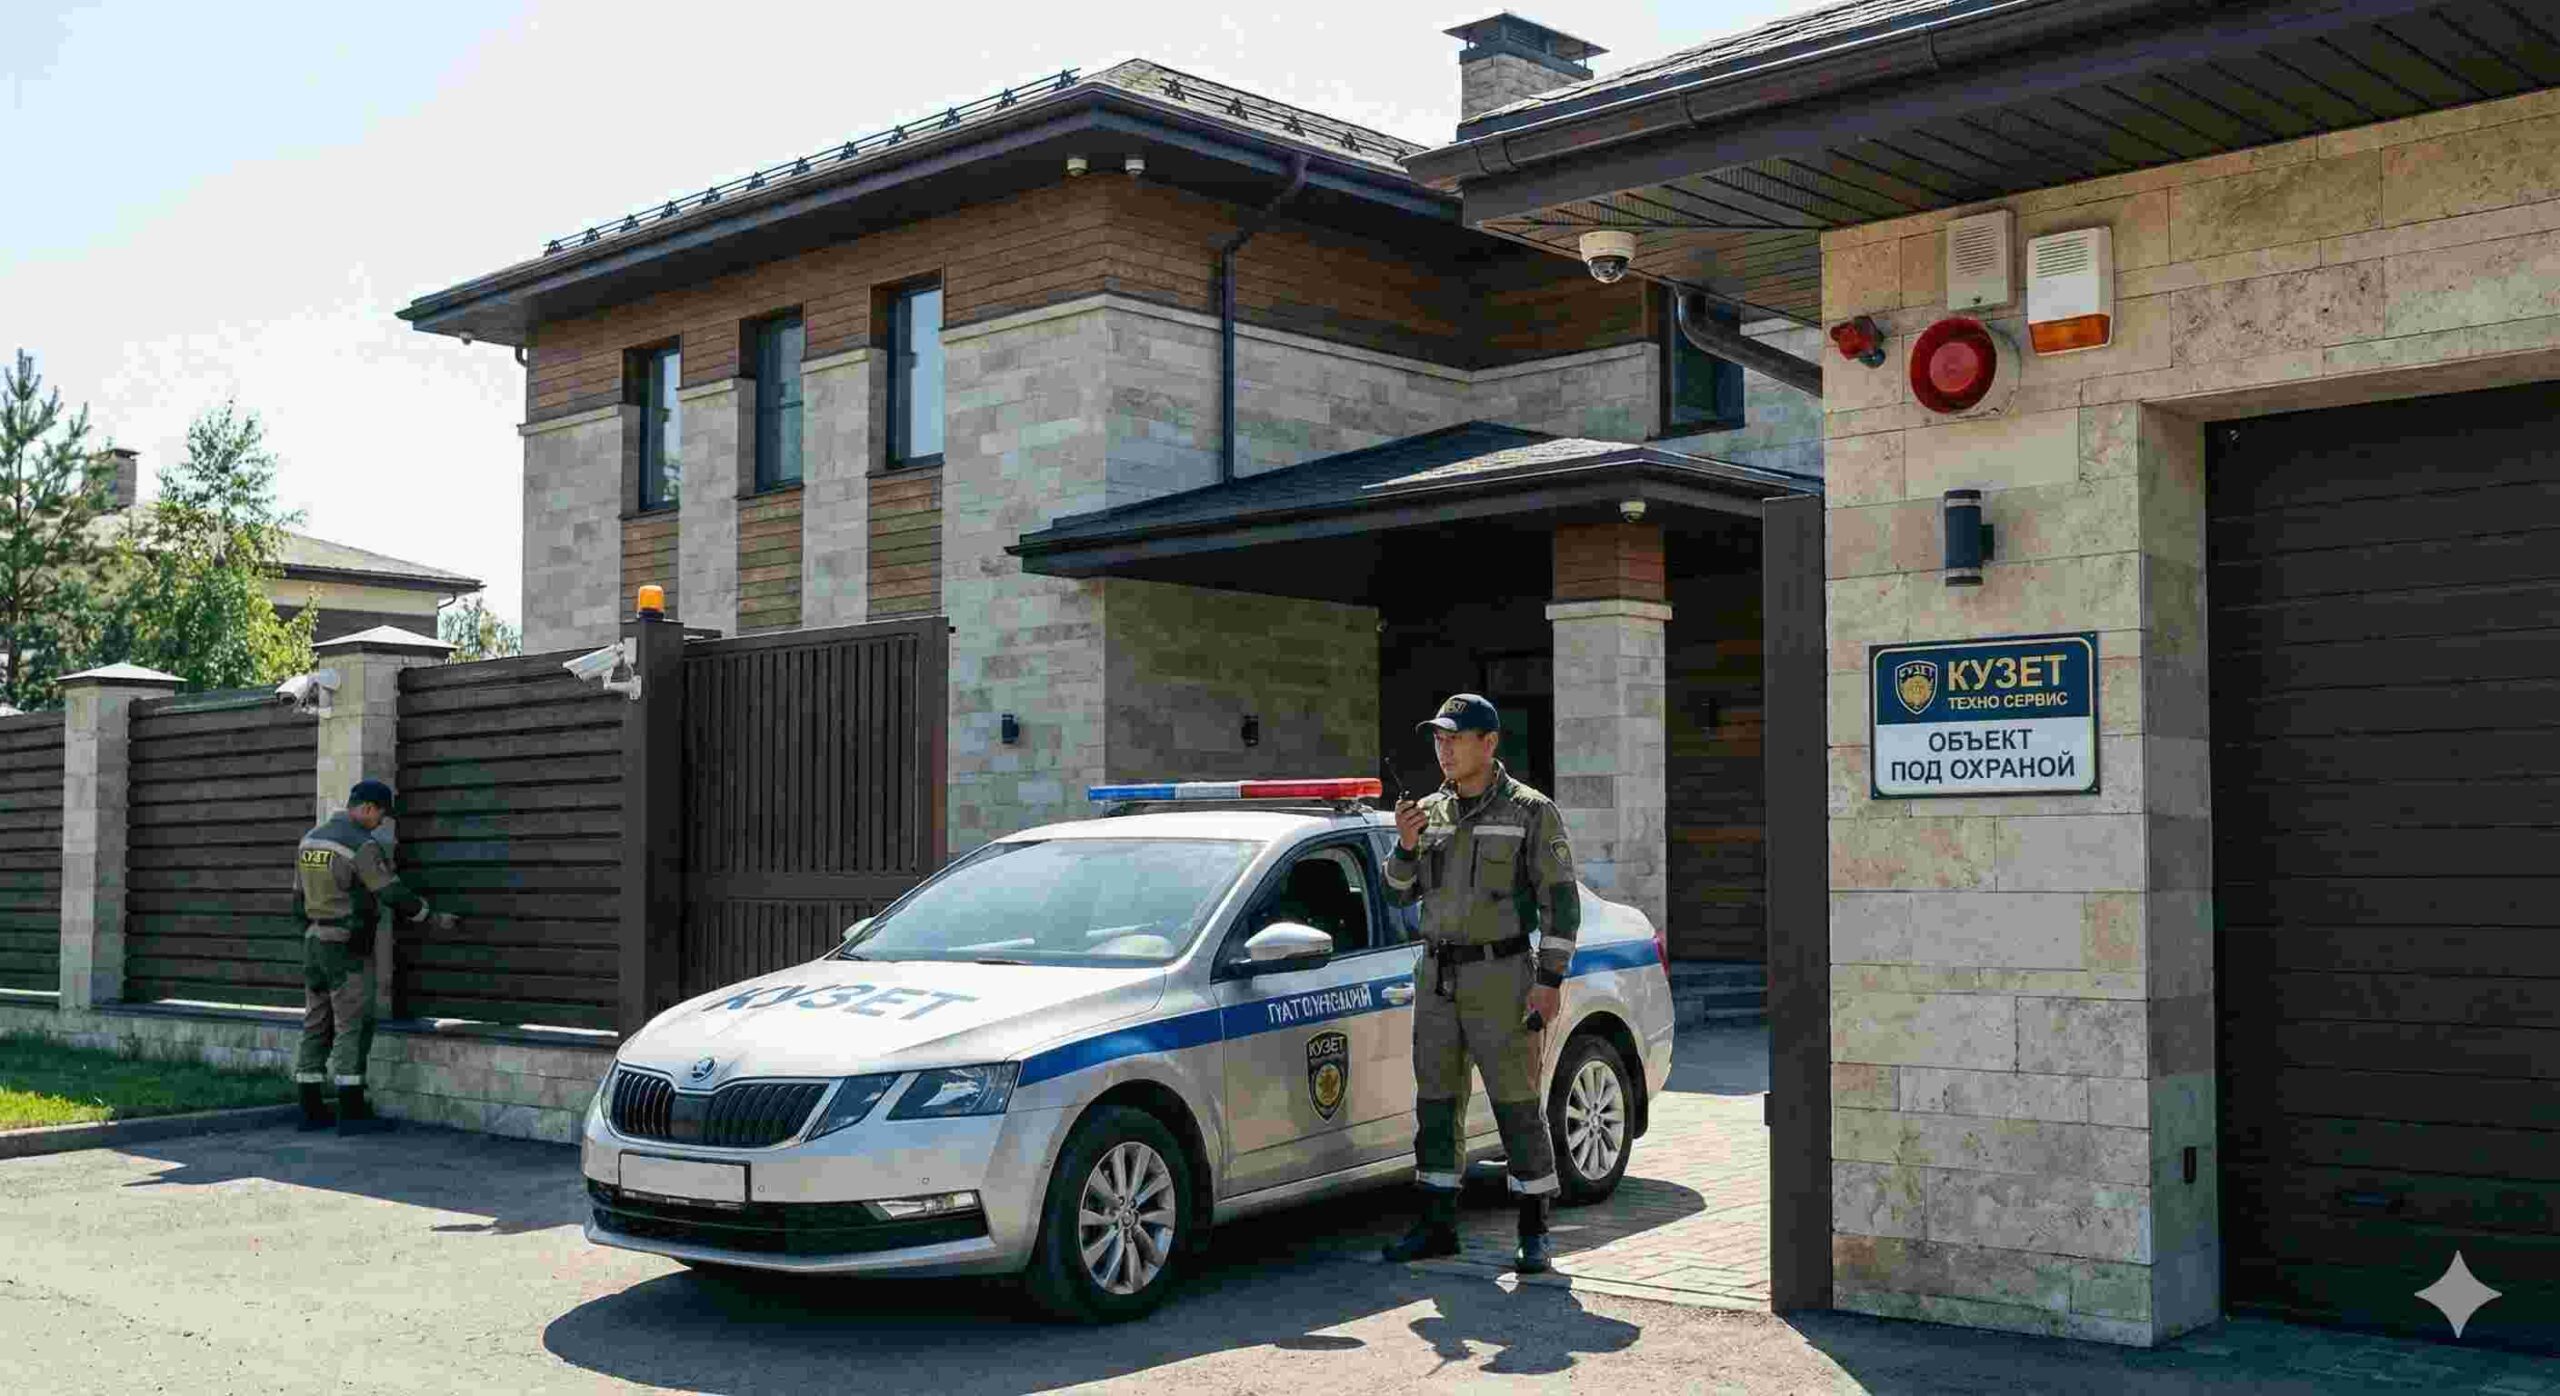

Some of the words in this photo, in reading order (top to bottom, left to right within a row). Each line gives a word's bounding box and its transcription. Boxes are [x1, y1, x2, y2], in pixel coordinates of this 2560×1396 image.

[1948, 654, 2067, 691] КУЗЕТ
[1948, 695, 1999, 710] ТЕХНО
[2003, 692, 2068, 709] СЕРВИС
[1928, 729, 2033, 752] ОБЪЕКТ
[1891, 761, 1943, 784] ПОД
[1950, 750, 2075, 781] ОХРАНОЙ
[702, 984, 980, 1020] КУЗЕТ
[1307, 1036, 1345, 1057] КУЗЕТ
